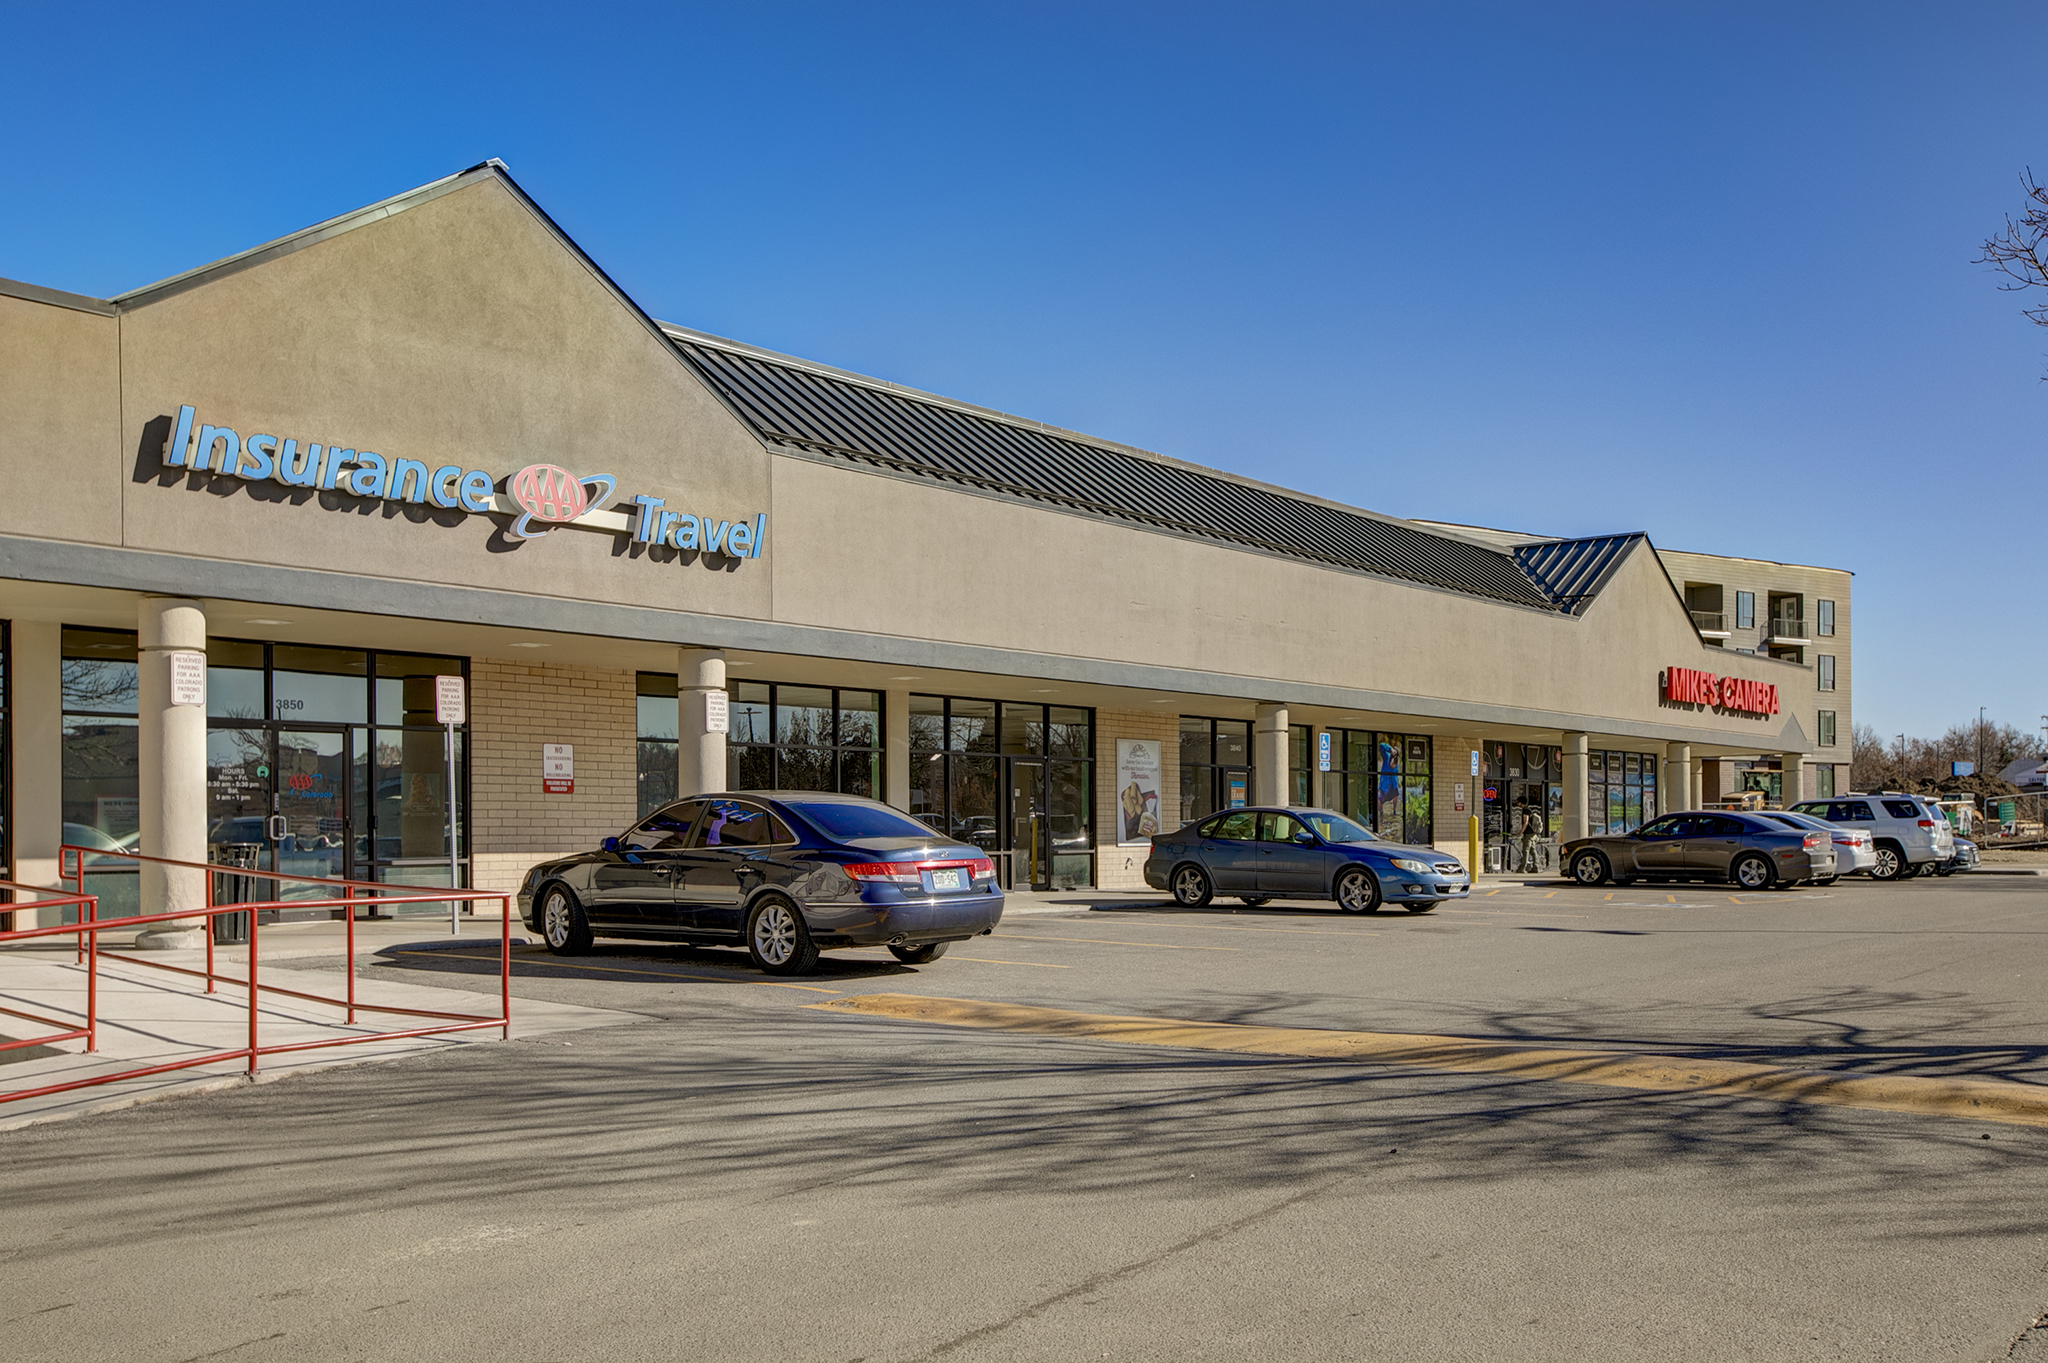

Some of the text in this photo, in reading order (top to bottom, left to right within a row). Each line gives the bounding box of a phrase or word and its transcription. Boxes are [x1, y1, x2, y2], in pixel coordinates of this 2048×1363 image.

[162, 404, 494, 514] Insurance
[630, 493, 767, 559] Travel
[276, 699, 304, 710] 3850
[1667, 665, 1780, 714] MIKE'S CAMERA
[1509, 767, 1519, 776] 3830
[1483, 789, 1497, 799] OPEN
